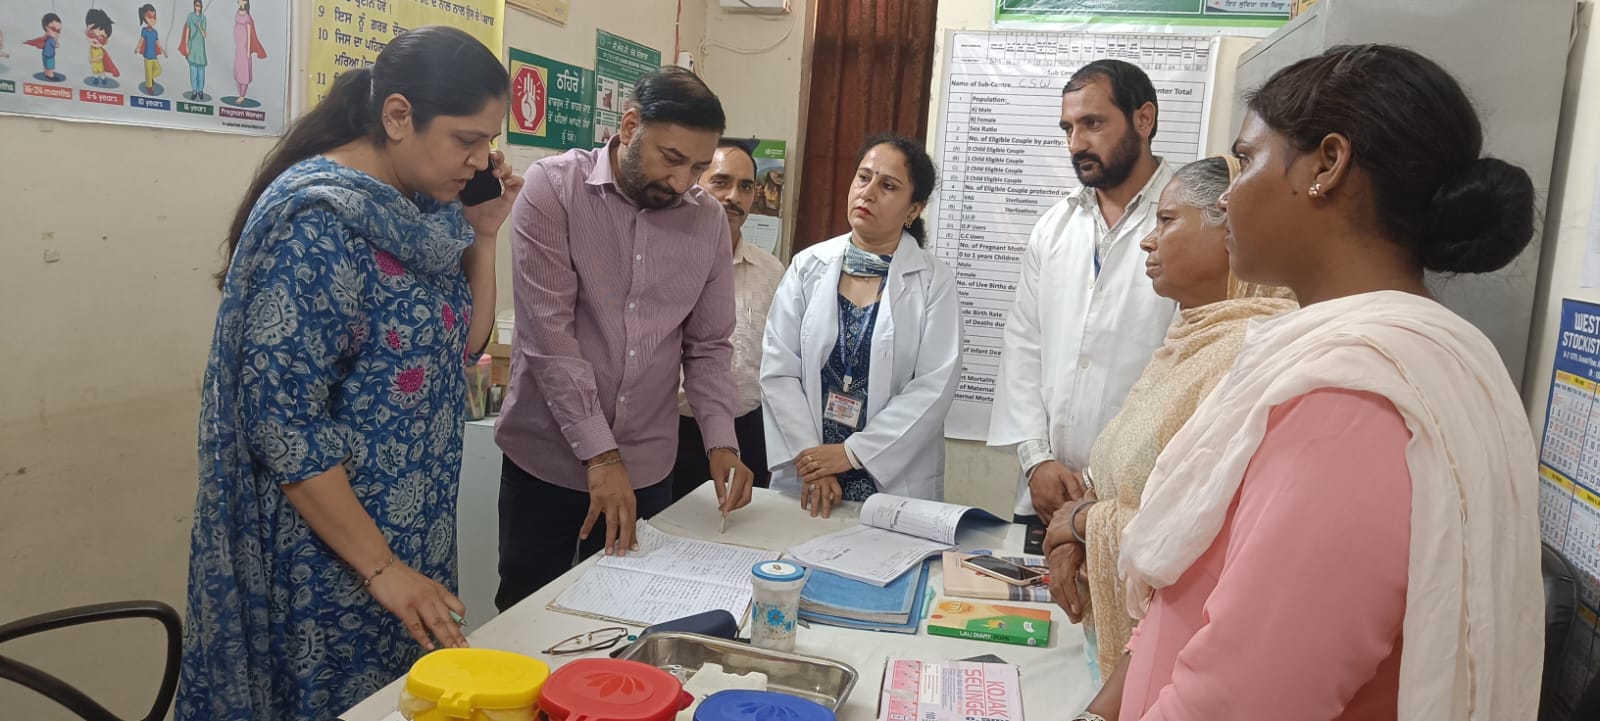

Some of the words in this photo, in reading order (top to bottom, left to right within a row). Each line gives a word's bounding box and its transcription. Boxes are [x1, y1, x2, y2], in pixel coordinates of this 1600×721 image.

[318, 6, 325, 17] 9
[318, 28, 328, 40] 10
[317, 72, 326, 85] 11
[1174, 87, 1193, 96] Total
[99, 94, 118, 103] years
[146, 99, 163, 108] years
[989, 136, 1010, 144] Eligible
[1011, 137, 1033, 145] Couple
[1007, 186, 1028, 194] Couple
[967, 375, 995, 384] Mortality
[967, 384, 994, 392] Maternal
[973, 632, 992, 641] DIARY
[964, 669, 985, 717] SELINGE
[986, 680, 1009, 719] KOJAK
